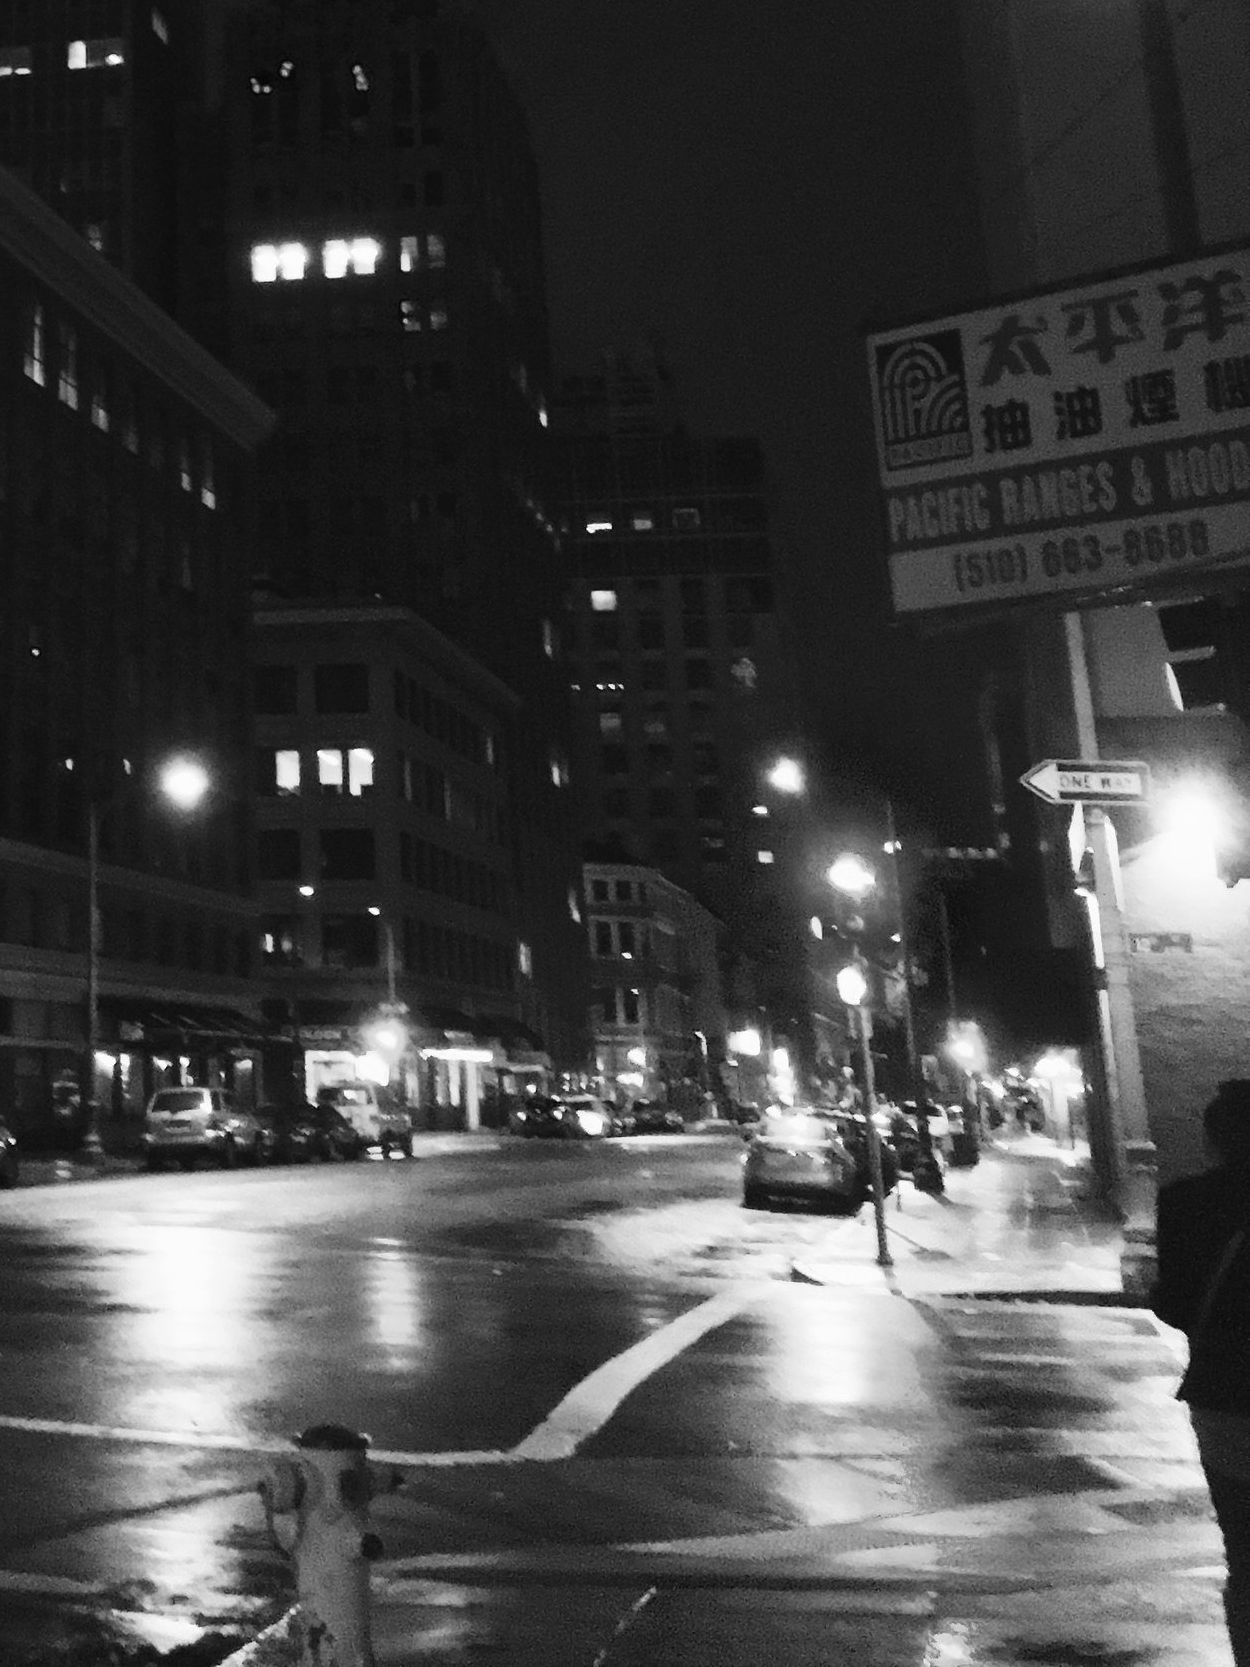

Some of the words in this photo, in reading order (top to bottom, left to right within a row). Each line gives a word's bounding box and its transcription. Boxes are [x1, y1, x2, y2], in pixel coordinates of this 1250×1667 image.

[979, 269, 1244, 387] 太平洋
[888, 483, 990, 542] PACIFIC
[1000, 461, 1116, 524] RANGES
[1131, 456, 1153, 506] &
[954, 543, 1027, 591] (510)
[1059, 774, 1091, 790] ONE
